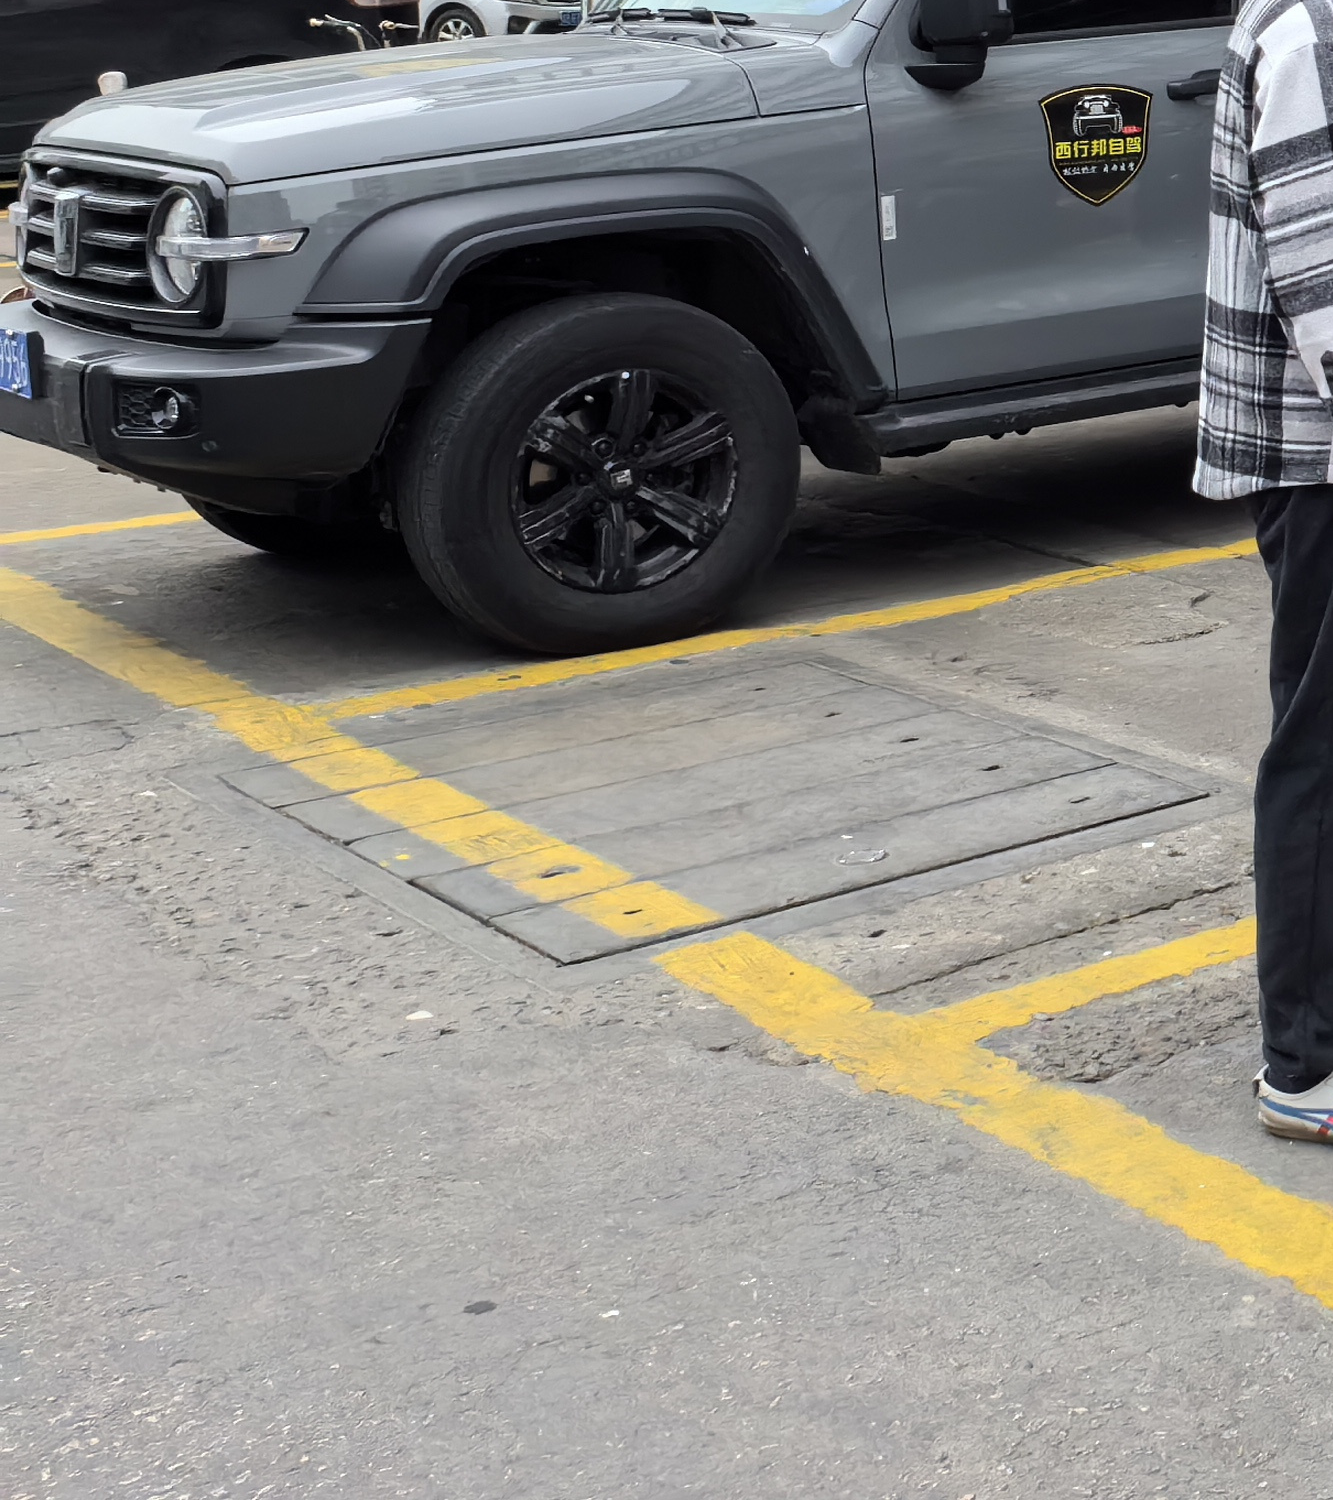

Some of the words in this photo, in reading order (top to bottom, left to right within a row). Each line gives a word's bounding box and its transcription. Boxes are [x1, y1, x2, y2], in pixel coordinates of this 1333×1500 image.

[1055, 137, 1142, 160] 西行邦自驾
